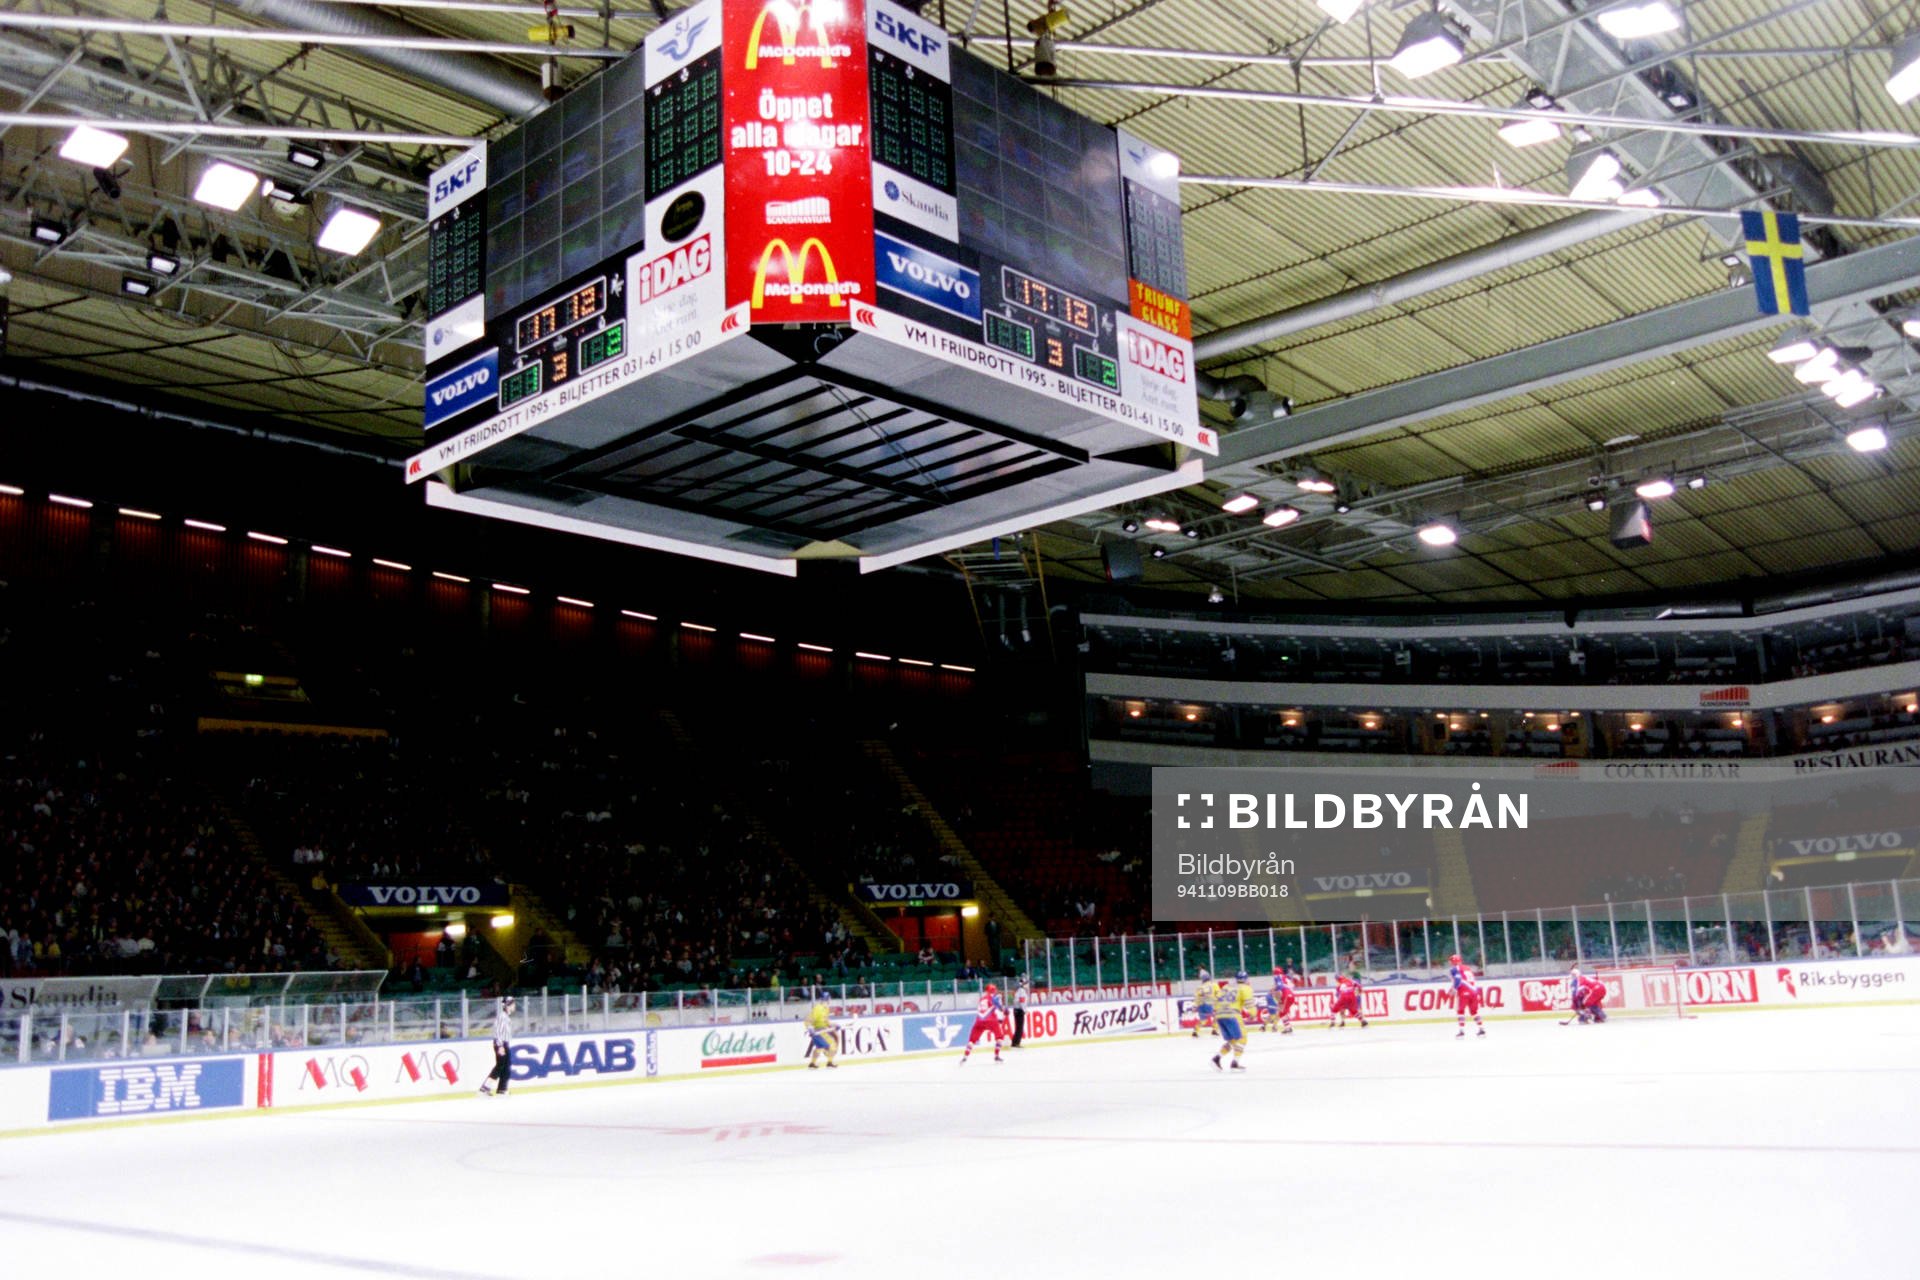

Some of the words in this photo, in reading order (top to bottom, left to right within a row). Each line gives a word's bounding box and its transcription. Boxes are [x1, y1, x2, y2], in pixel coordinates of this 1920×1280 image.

[874, 10, 942, 57] SKF
[758, 44, 851, 58] McDonald's
[759, 88, 833, 121] Öppet
[731, 122, 778, 148] alla
[784, 123, 862, 149] dagar
[763, 151, 832, 176] 10-24
[434, 158, 480, 203] SKF
[901, 190, 949, 221] Skandia
[764, 281, 861, 296] McDonald's
[887, 251, 970, 299] VOLVO
[1136, 282, 1180, 317] TRIUMF
[1142, 305, 1178, 335] GLASS
[431, 367, 490, 406] VOLVO
[439, 444, 455, 460] VM
[463, 411, 521, 449] FRIIDROTT
[525, 400, 549, 421] 1995
[559, 367, 620, 406] BILJETTER
[623, 347, 662, 377] 031-61
[669, 342, 682, 357] 15
[686, 330, 701, 348] 00
[905, 324, 928, 345] VM
[941, 338, 1015, 375] FRIIDROTT
[1020, 365, 1047, 387] 1995
[1058, 380, 1117, 413] BILJETTER
[1120, 403, 1153, 426] 031-61
[1158, 417, 1169, 431] 15
[1171, 421, 1184, 437] 00
[1790, 831, 1902, 855] VOLVO
[368, 886, 480, 904] VOLVO
[868, 883, 960, 899] VOLVO
[1313, 871, 1412, 892] VOLVO
[1646, 970, 1753, 1004] THORN
[1800, 969, 1905, 989] Riksbyggen
[10, 985, 120, 1010] Skandia
[1072, 1001, 1153, 1035] FRISTADS
[701, 1029, 776, 1057] Oddset
[508, 1037, 636, 1081] SAAB
[97, 1063, 202, 1114] IBM
